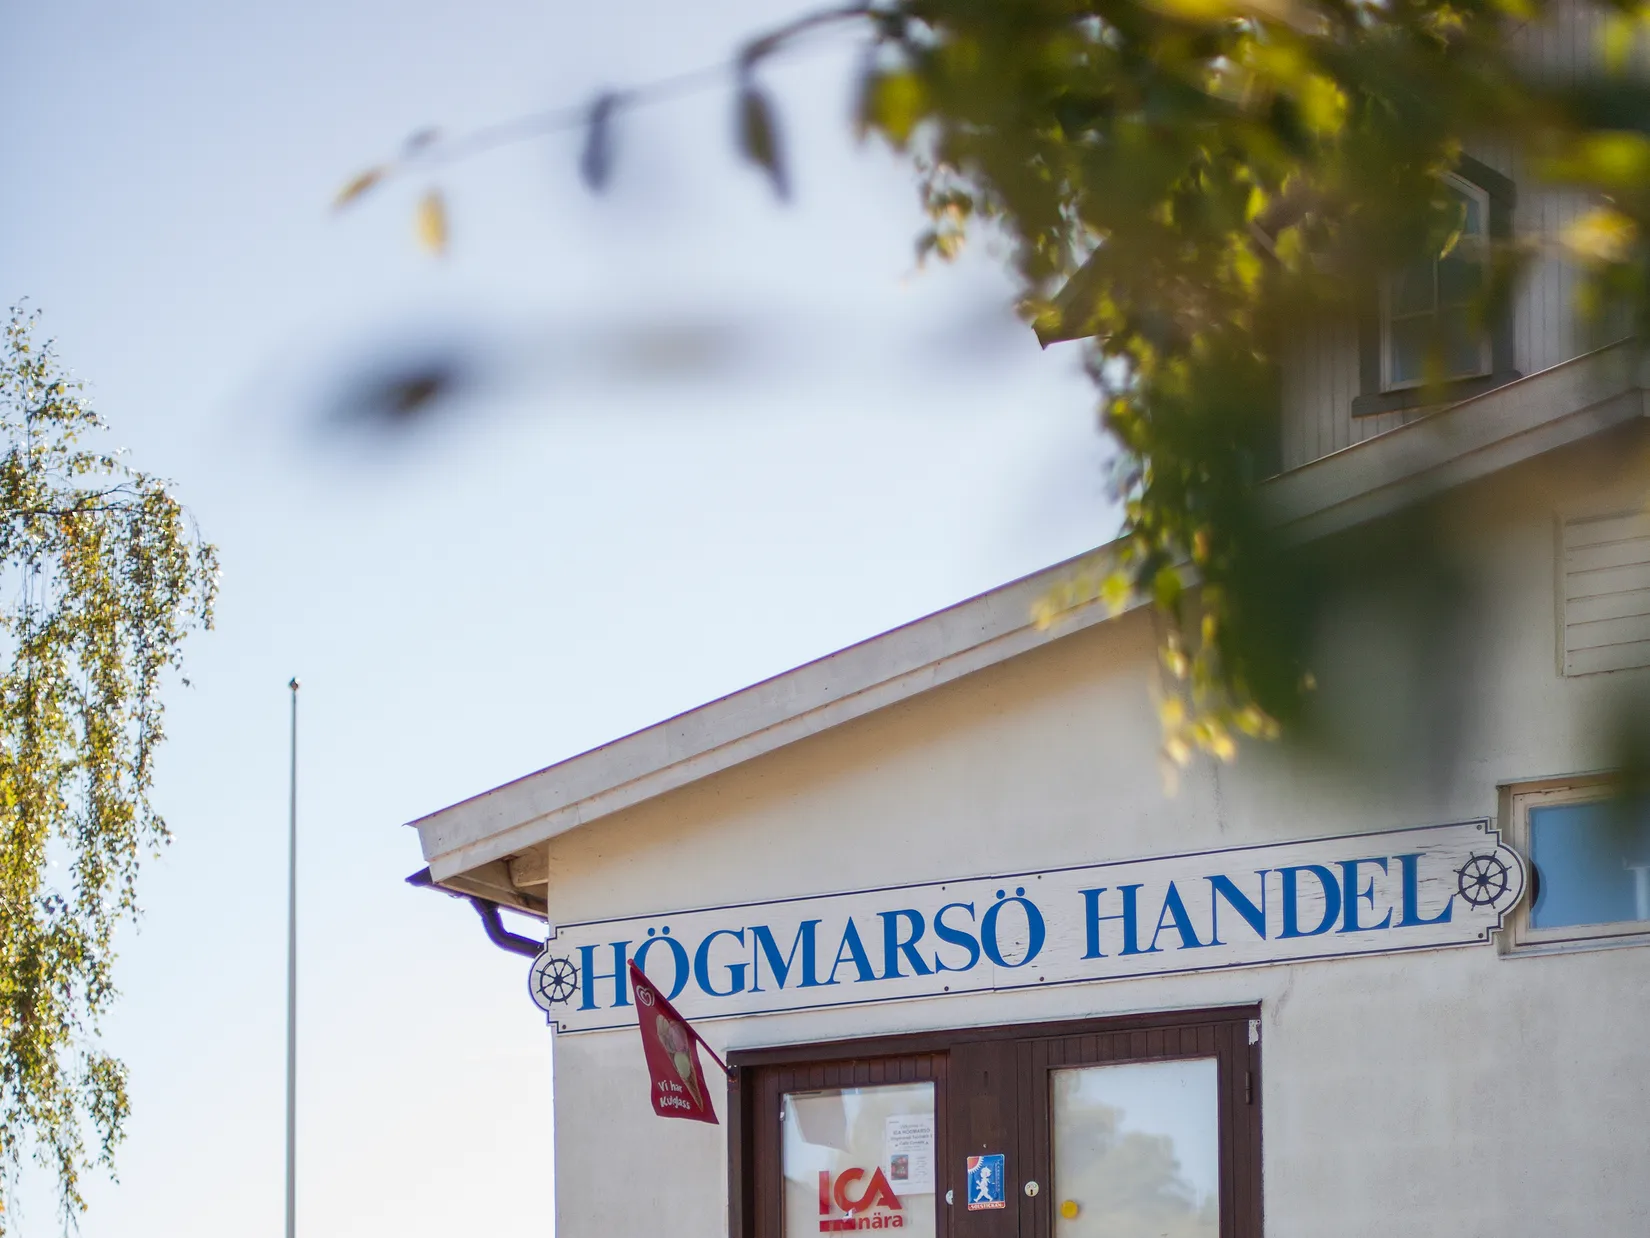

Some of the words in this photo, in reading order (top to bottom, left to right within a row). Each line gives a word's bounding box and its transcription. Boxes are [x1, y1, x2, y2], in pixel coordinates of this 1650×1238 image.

[576, 886, 1047, 1012] HÖGMARSÖ
[1078, 853, 1455, 961] HANDEL
[658, 1080, 668, 1091] Vi
[670, 1081, 682, 1093] har
[819, 1166, 902, 1214] ICA
[858, 1212, 904, 1230] nära
